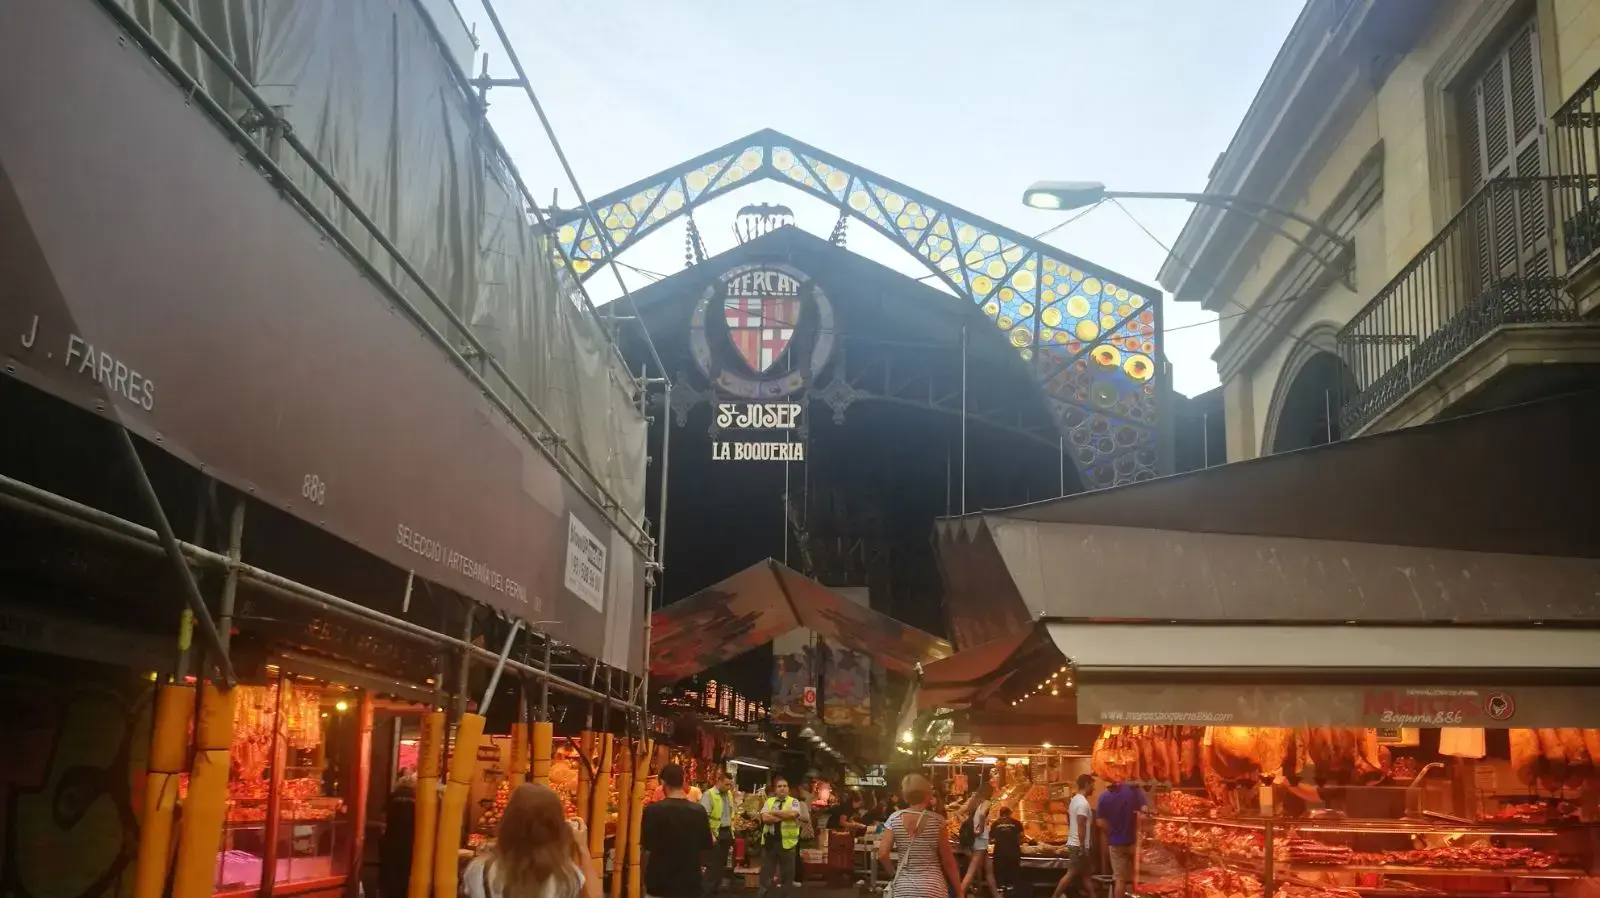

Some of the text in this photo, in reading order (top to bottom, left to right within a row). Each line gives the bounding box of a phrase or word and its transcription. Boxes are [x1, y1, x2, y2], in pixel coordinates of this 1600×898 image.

[728, 272, 799, 296] MERCAT
[65, 334, 155, 411] FARRES
[736, 404, 802, 429] JOSEP
[712, 442, 804, 461] LA BOQUERIA
[302, 474, 326, 506] 888
[490, 571, 504, 592] DEL
[505, 578, 528, 603] PERNIL
[1363, 688, 1481, 716] Marcos
